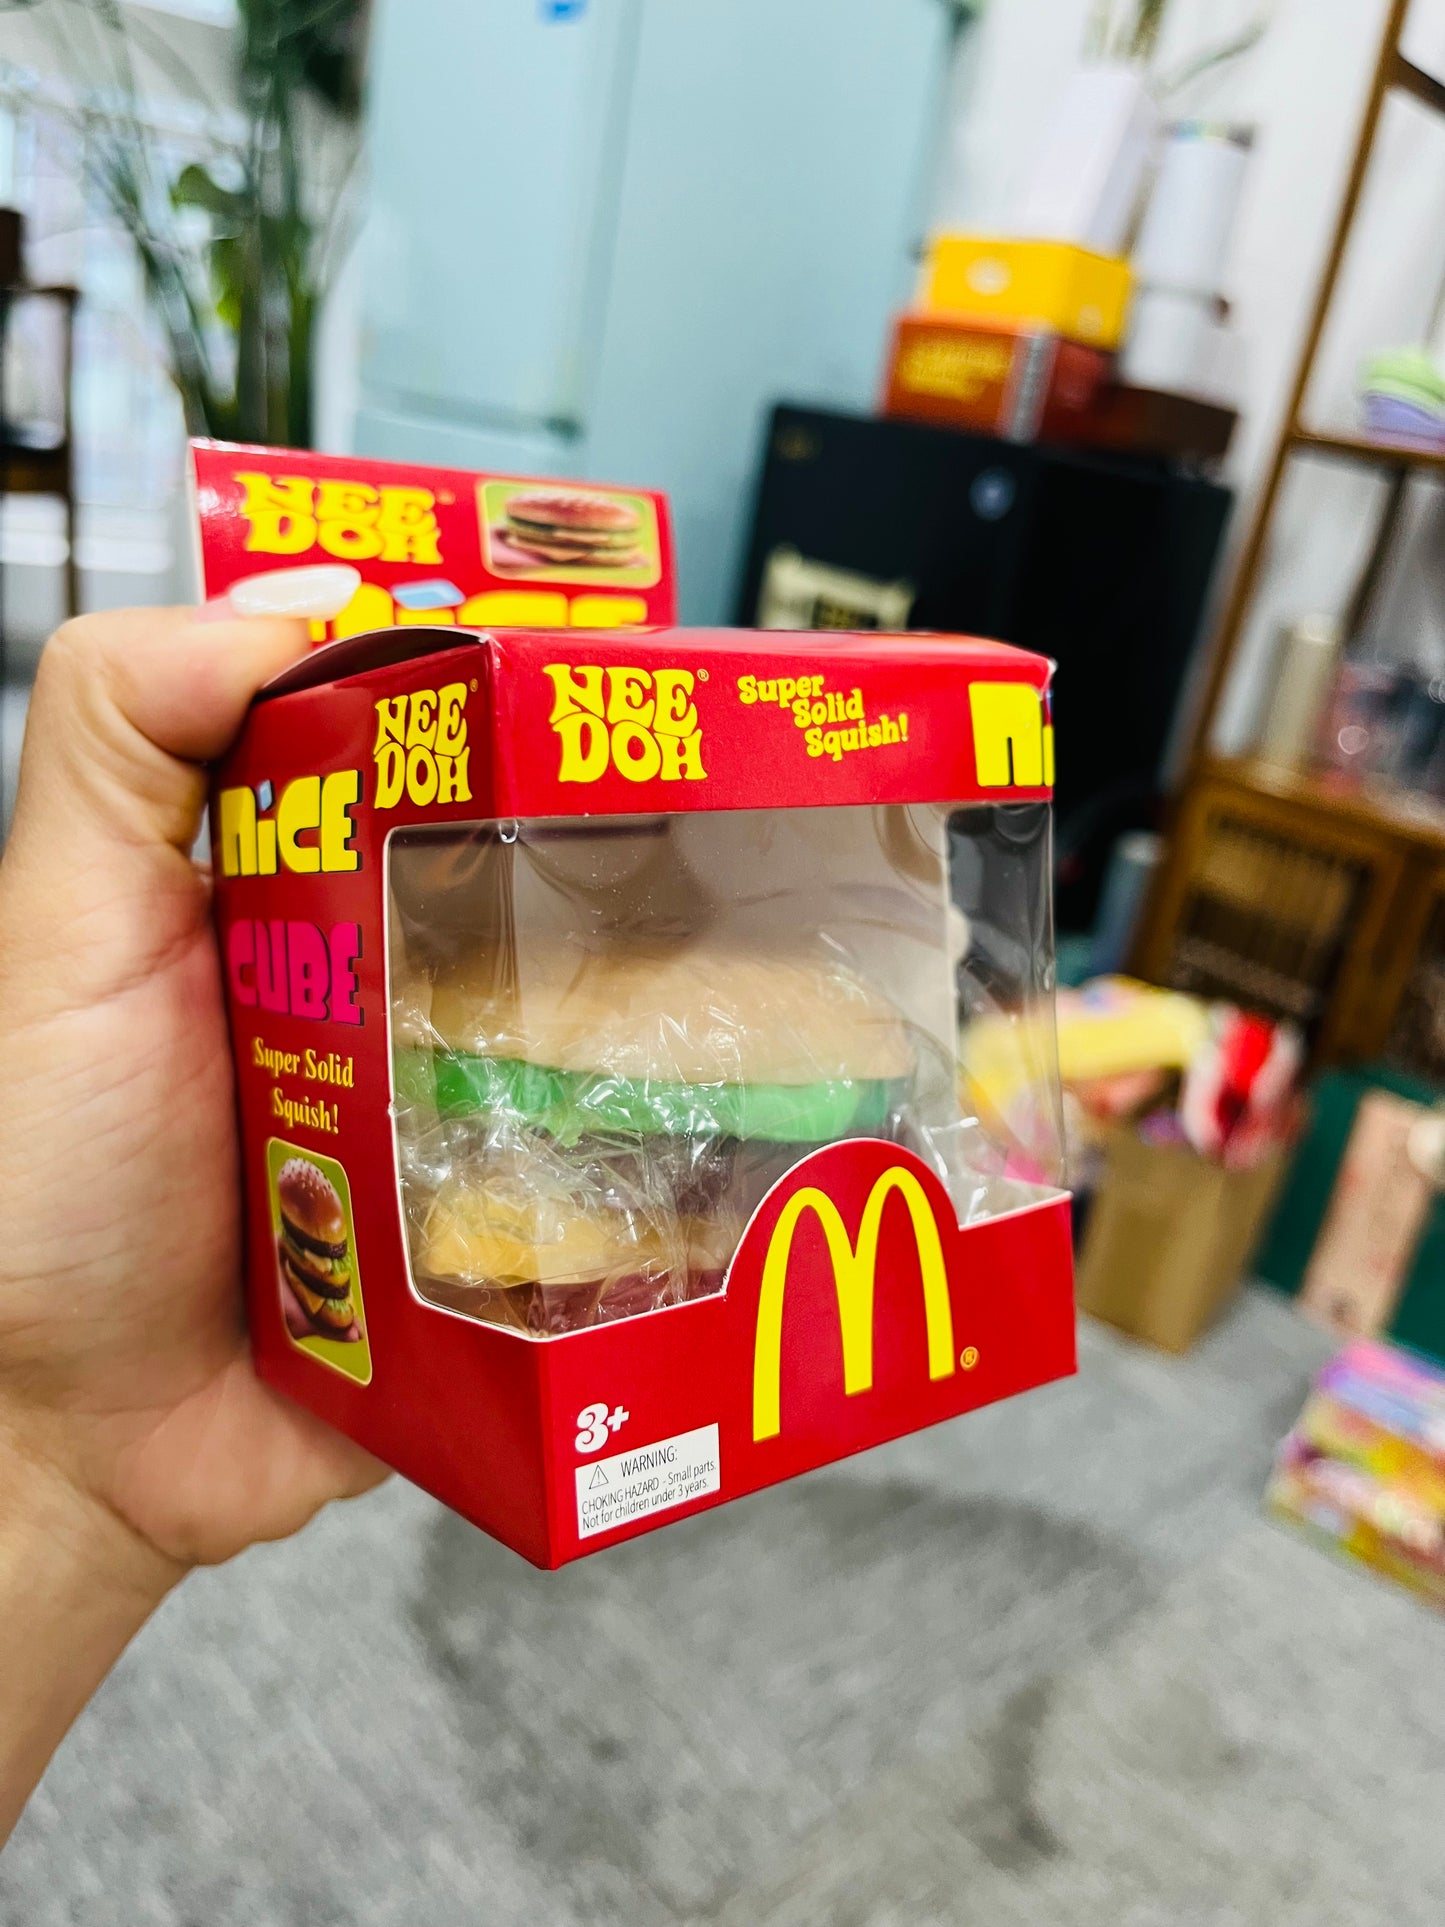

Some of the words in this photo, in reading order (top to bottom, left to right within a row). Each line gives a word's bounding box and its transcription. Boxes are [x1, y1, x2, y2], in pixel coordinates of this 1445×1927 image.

[235, 471, 437, 535] NEE
[245, 508, 443, 564] DOH
[543, 664, 699, 738] NEE
[737, 675, 825, 709] Super
[791, 688, 865, 728] Solid
[373, 682, 468, 757] NEE
[804, 713, 908, 762] Squish!
[551, 712, 708, 783] DOH
[373, 742, 473, 809] DOH
[230, 919, 364, 1025] CUBE
[254, 1036, 300, 1078] Super
[305, 1048, 354, 1088] Solid
[273, 1087, 339, 1134] Squish!
[575, 1402, 630, 1453] 3+
[581, 1488, 624, 1515] CHOKING
[624, 1477, 660, 1502] HAZARD
[668, 1468, 692, 1486] Small
[693, 1459, 716, 1479] parts.
[620, 1445, 678, 1477] WARNING:
[582, 1515, 600, 1530] Not
[601, 1508, 615, 1524] for
[615, 1497, 650, 1519] children
[652, 1487, 676, 1507] under
[677, 1484, 684, 1498] 3
